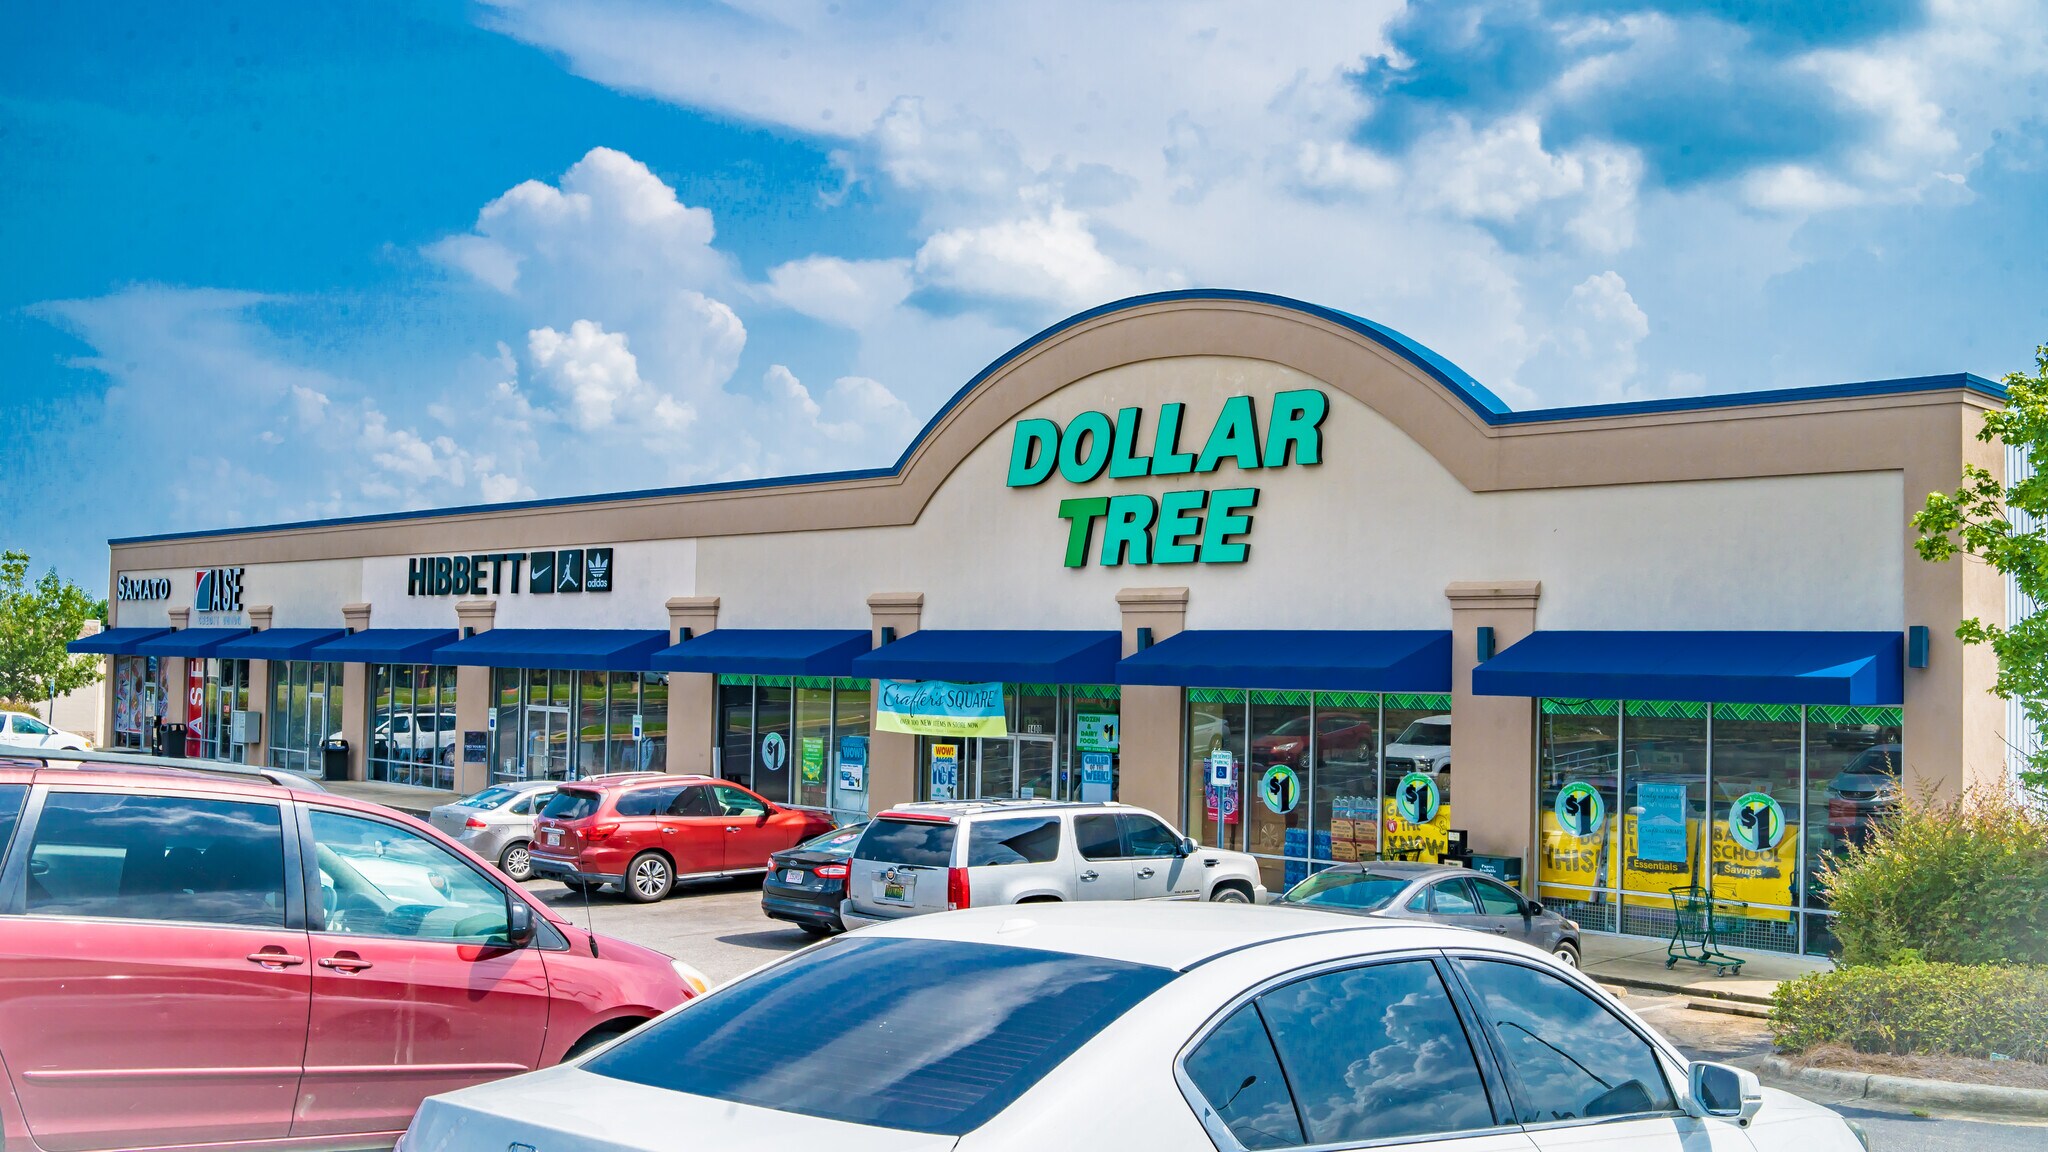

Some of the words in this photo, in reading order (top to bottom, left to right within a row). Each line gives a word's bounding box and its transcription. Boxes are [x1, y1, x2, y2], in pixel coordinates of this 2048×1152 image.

[1007, 389, 1329, 488] DOLLAR
[1058, 487, 1261, 568] TREE
[408, 552, 527, 596] HIBBETT
[587, 578, 608, 588] adidas
[118, 575, 171, 600] SAMATO
[211, 567, 245, 611] ASE
[189, 659, 204, 736] ASE
[883, 684, 944, 718] Crafter's
[946, 690, 996, 710] SQUARE
[920, 719, 932, 727] NEW
[1103, 723, 1115, 742] $1
[767, 741, 781, 769] $1
[842, 747, 863, 758] WOW!
[935, 746, 954, 756] WOW!
[1085, 754, 1110, 765] CHILLER
[932, 762, 957, 786] ICE
[1269, 775, 1291, 812] $1
[1405, 783, 1429, 823] $1
[1565, 794, 1593, 837] $1
[1741, 805, 1772, 850] $1
[1386, 835, 1446, 856] KNOW
[1713, 844, 1782, 863] SCHOOL
[1633, 859, 1679, 871] Essentials
[1724, 864, 1762, 877] Savings
